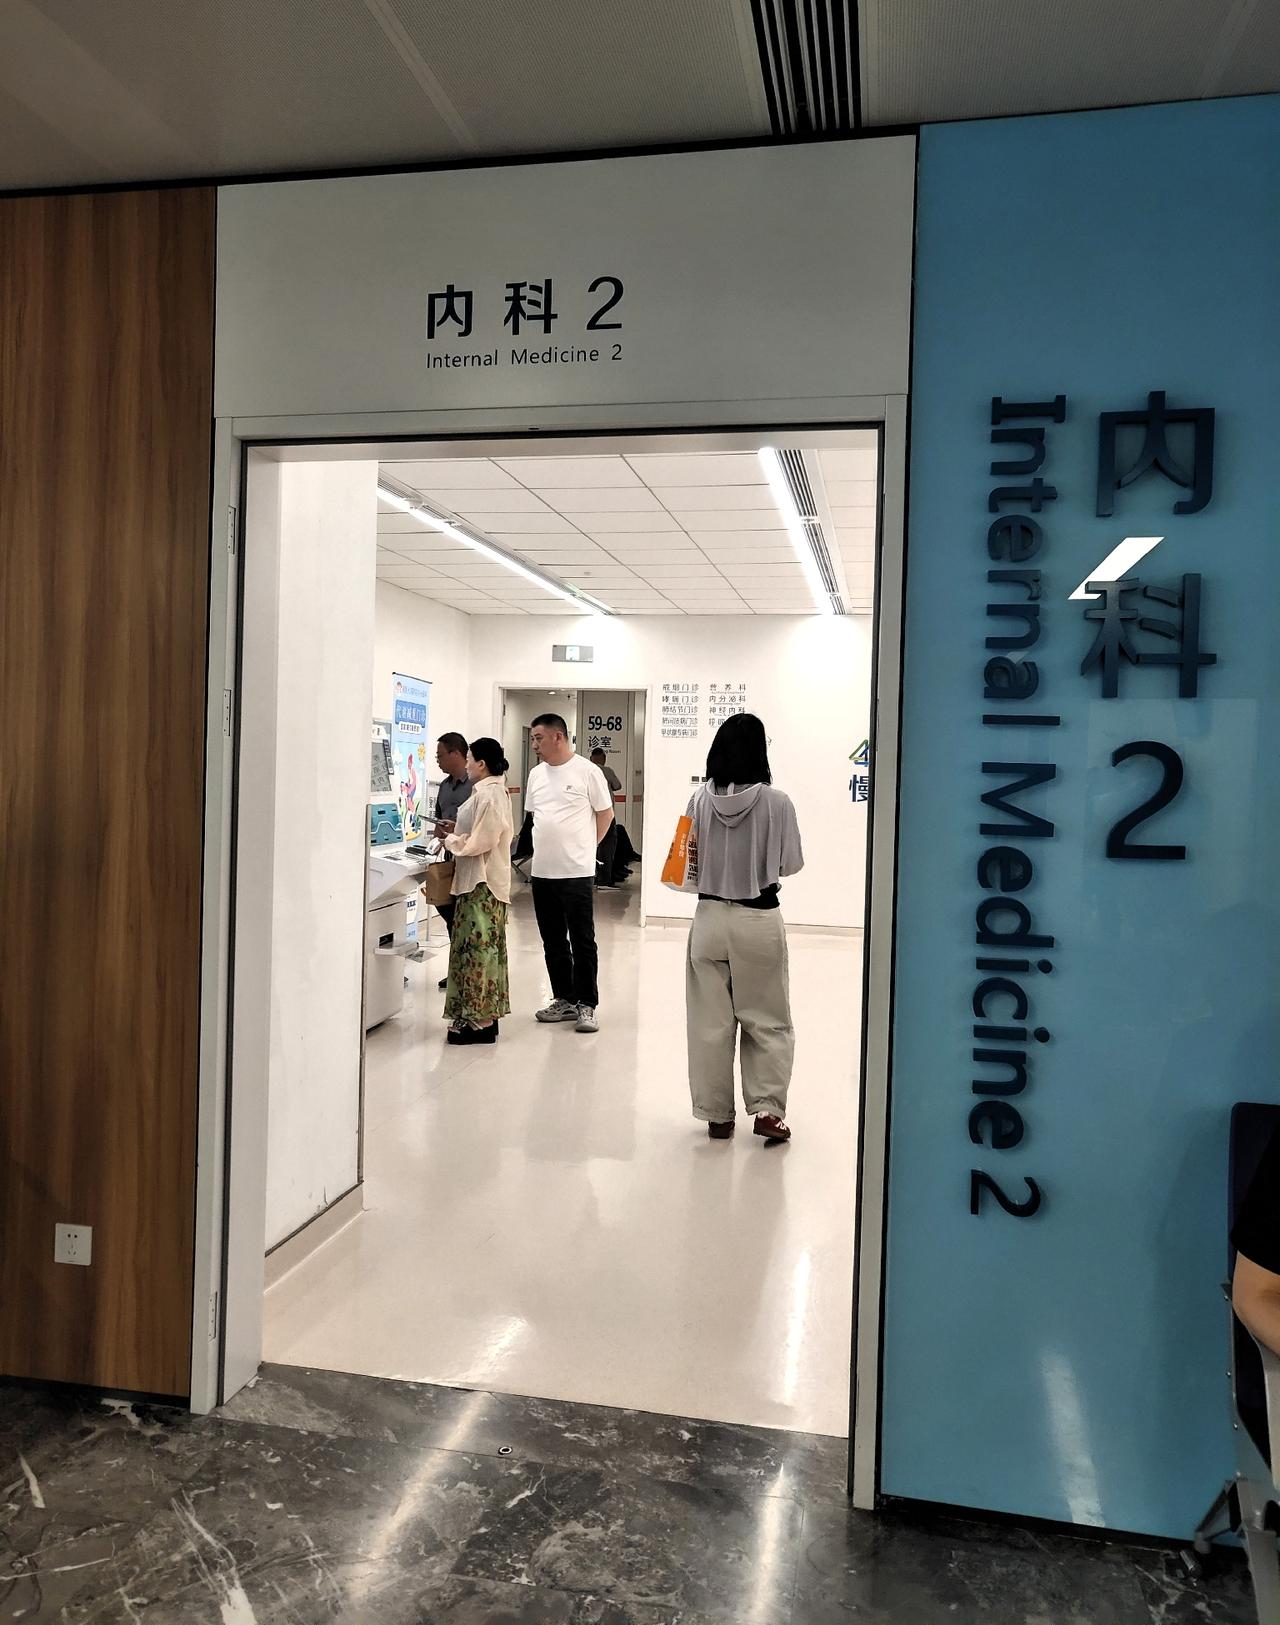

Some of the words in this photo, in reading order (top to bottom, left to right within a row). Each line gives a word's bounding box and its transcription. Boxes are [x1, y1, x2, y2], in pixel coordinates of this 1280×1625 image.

[427, 349, 498, 369] Internal
[511, 346, 599, 365] Medicine
[611, 343, 623, 361] 2
[982, 394, 1067, 726] Internal
[709, 683, 746, 691] 营养科
[709, 695, 746, 703] 内分泌科
[709, 706, 745, 714] 神经内科
[588, 716, 622, 731] 59-68
[588, 735, 611, 748] 诊室
[968, 761, 1057, 1149] Medicine
[970, 1169, 1042, 1218] 2
